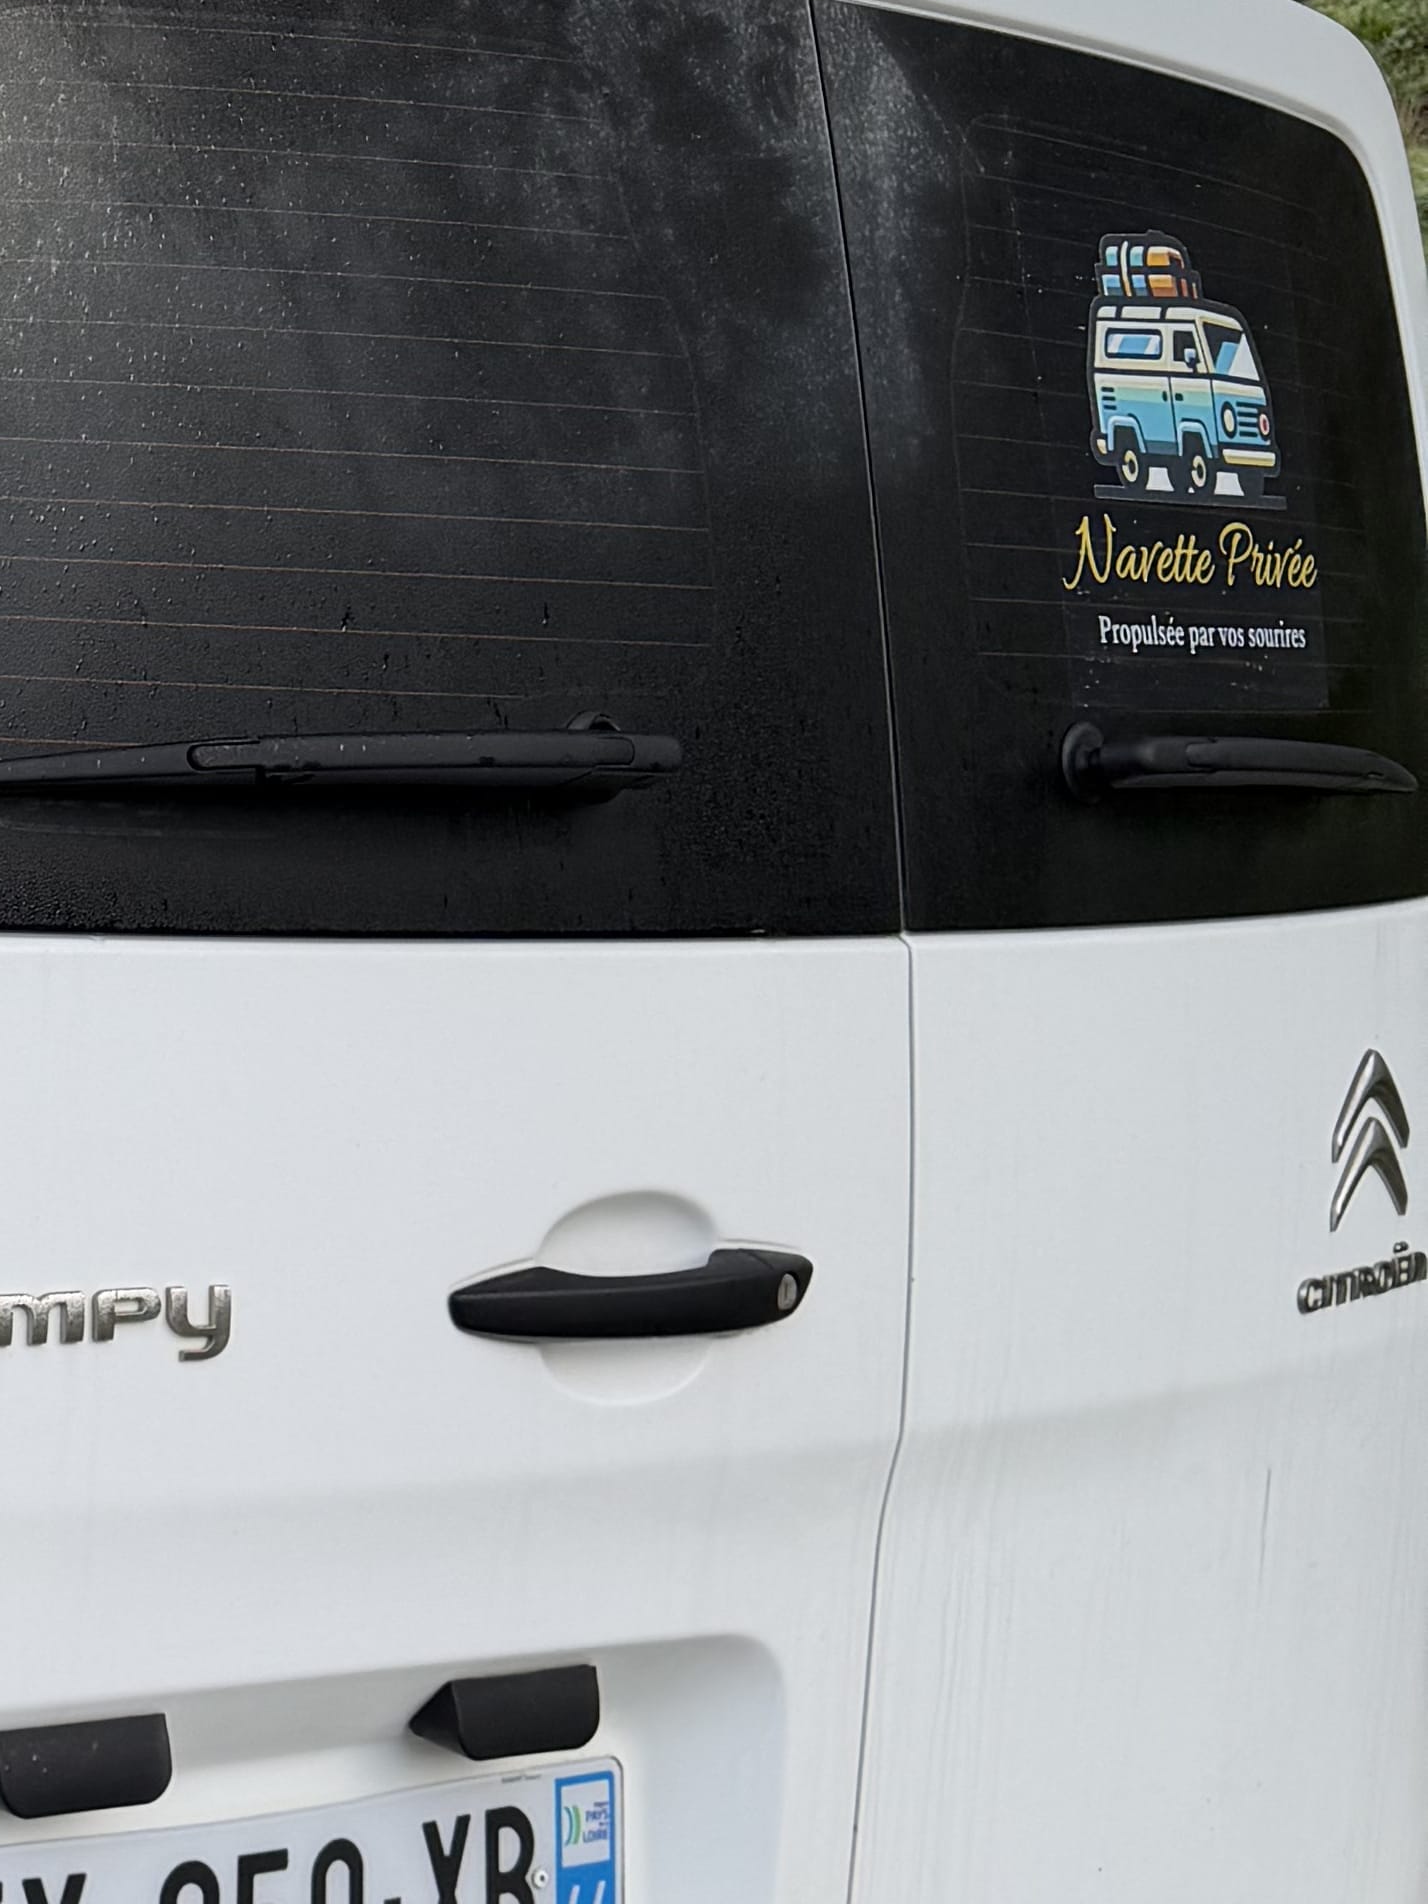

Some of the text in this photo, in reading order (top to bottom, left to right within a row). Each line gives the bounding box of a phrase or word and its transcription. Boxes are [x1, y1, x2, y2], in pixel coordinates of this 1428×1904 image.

[1062, 512, 1318, 590] Navette Privée
[1098, 614, 1307, 654] Propulsée par vos sourires
